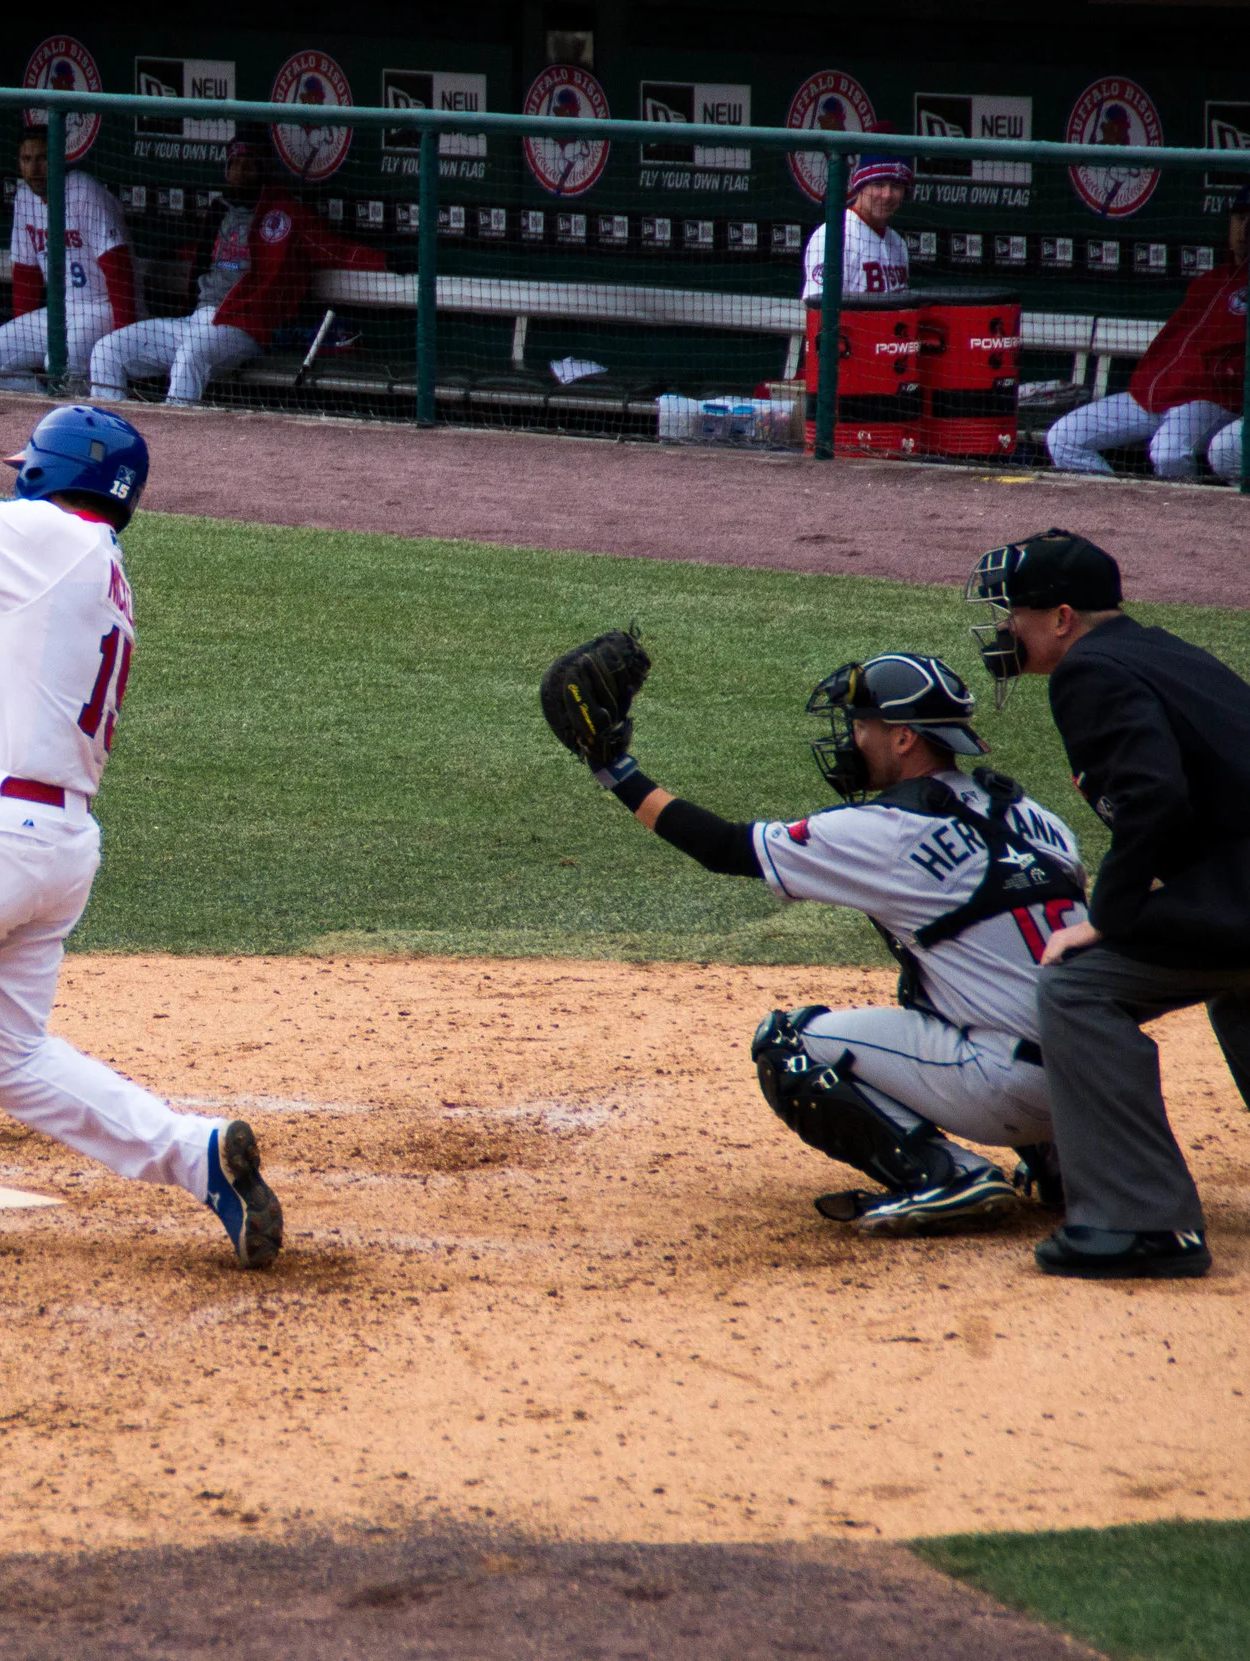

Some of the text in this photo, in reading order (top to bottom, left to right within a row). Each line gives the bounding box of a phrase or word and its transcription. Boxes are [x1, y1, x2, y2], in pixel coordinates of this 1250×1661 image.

[28, 41, 98, 90] UFFALO BISON
[191, 77, 228, 99] NEW
[276, 55, 348, 105] UFFALO BISON
[441, 90, 478, 111] NEW
[527, 68, 606, 118] UFFALO BISON
[792, 76, 873, 128] UFFALO BISON
[702, 102, 743, 125] NEW
[980, 114, 1023, 138] NEW
[134, 140, 228, 161] FLY YOUR OWN FLA
[381, 156, 486, 179] FLY YOU WN FLAG
[639, 170, 750, 192] FLY YOUR OWN FLAG
[913, 183, 1031, 208] FLY YOUR OWN FLAG
[1202, 195, 1227, 213] FLY
[110, 480, 130, 499] 15
